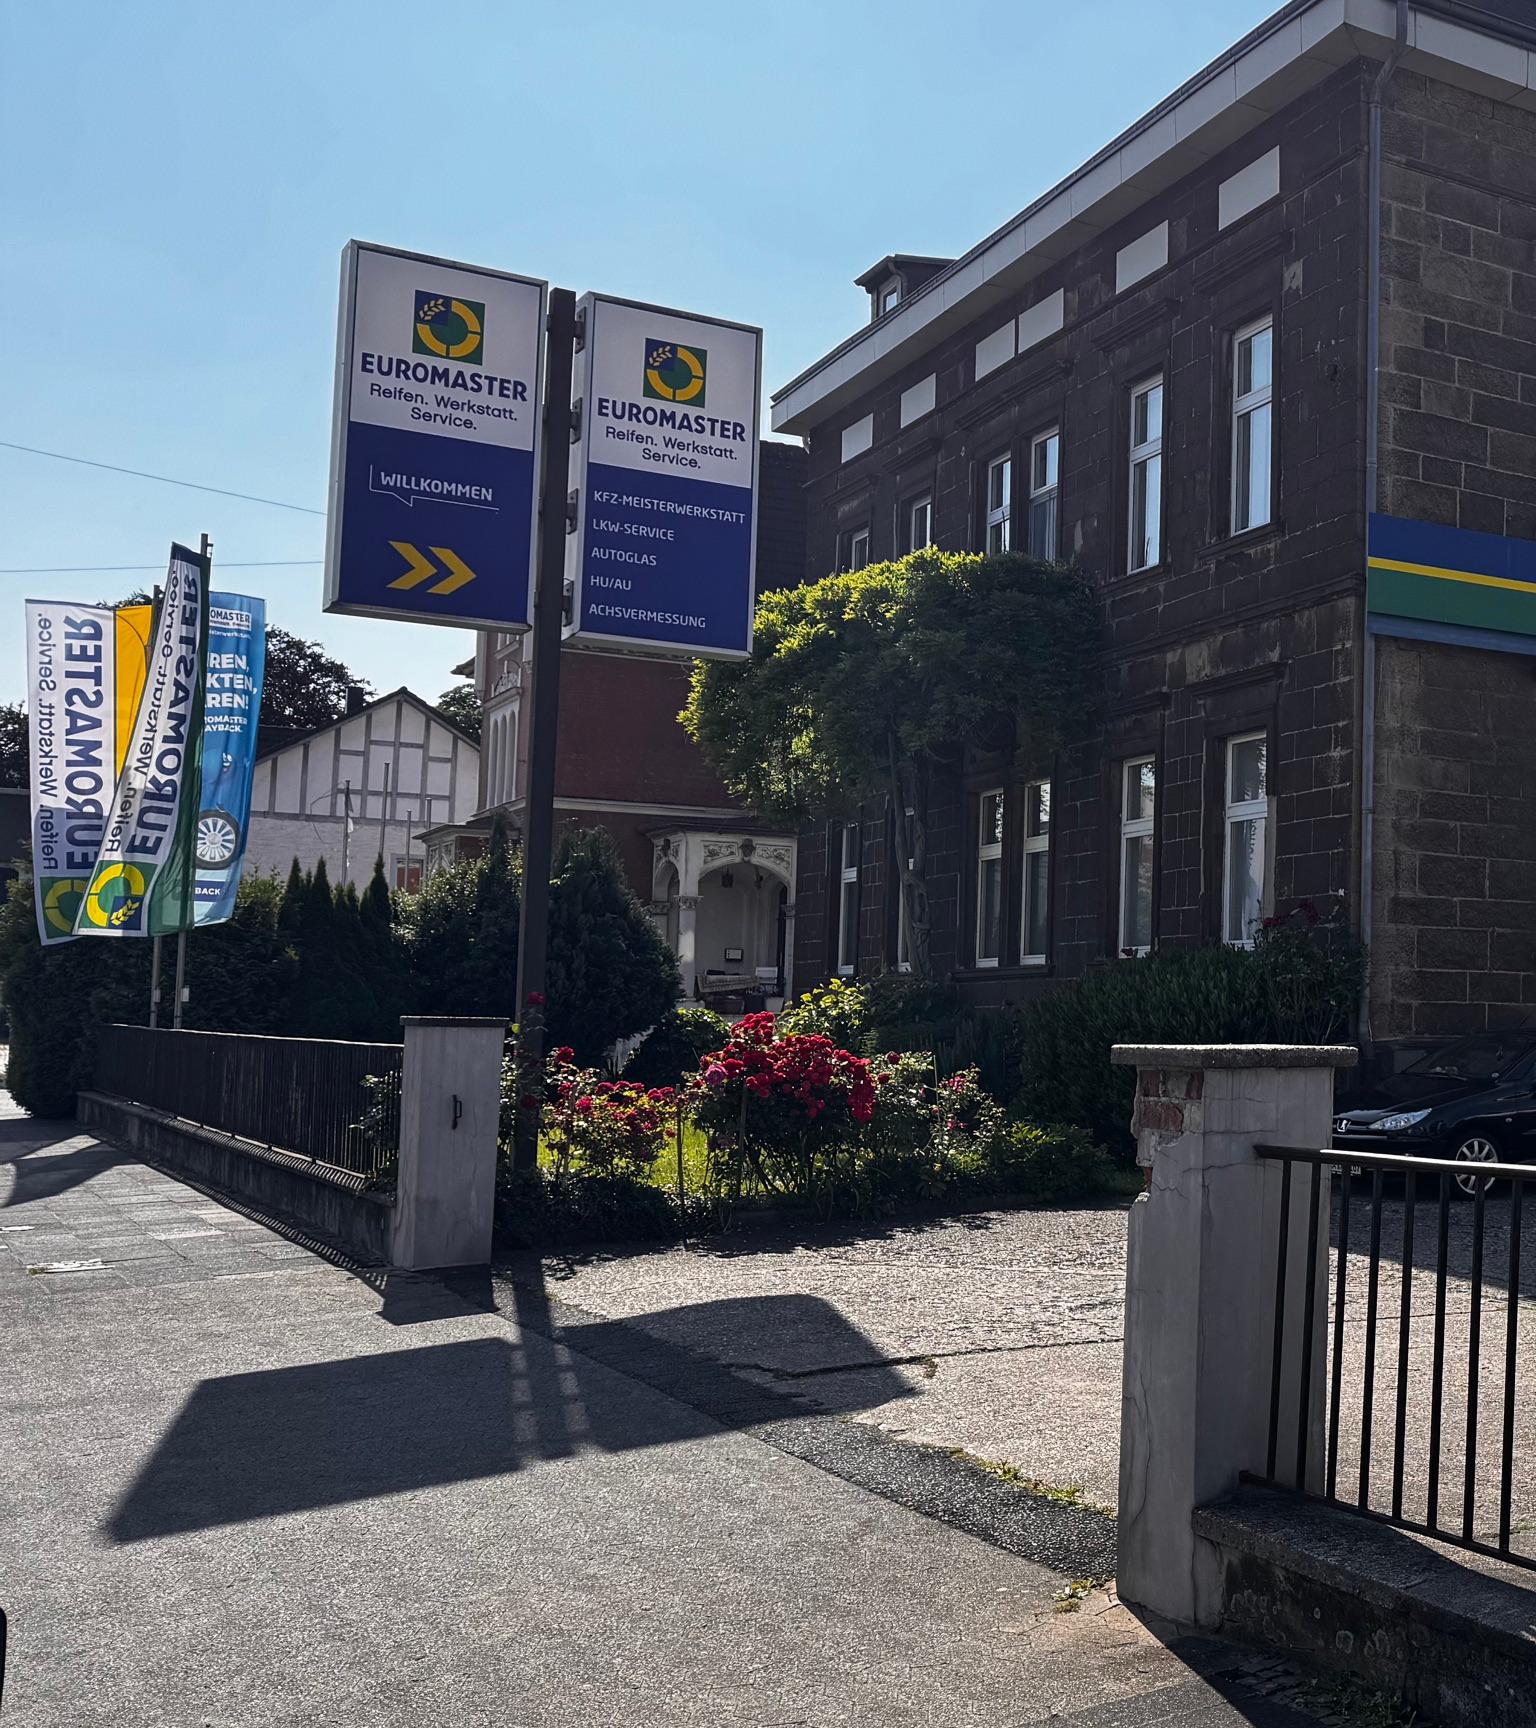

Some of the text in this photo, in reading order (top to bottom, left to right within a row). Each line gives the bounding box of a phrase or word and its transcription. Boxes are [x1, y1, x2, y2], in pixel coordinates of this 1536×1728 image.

[361, 352, 528, 402] EUROMASTER
[370, 383, 518, 421] Reifen. Werkstatt.
[410, 407, 477, 430] Service.
[598, 397, 746, 442] EUROMASTER
[605, 426, 737, 460] Reifen. Werkstatt.
[642, 448, 701, 469] Service.
[380, 471, 493, 501] WILLKOMMEN
[594, 490, 745, 524] KFZ-MEISTERWERKSTATT
[593, 518, 675, 541] LKW-SERVICE
[591, 547, 657, 566] AUTOGLAS
[590, 575, 632, 590] HU/AU
[210, 608, 250, 624] OMASTER
[588, 603, 706, 628] ACHSVERMESSUNG
